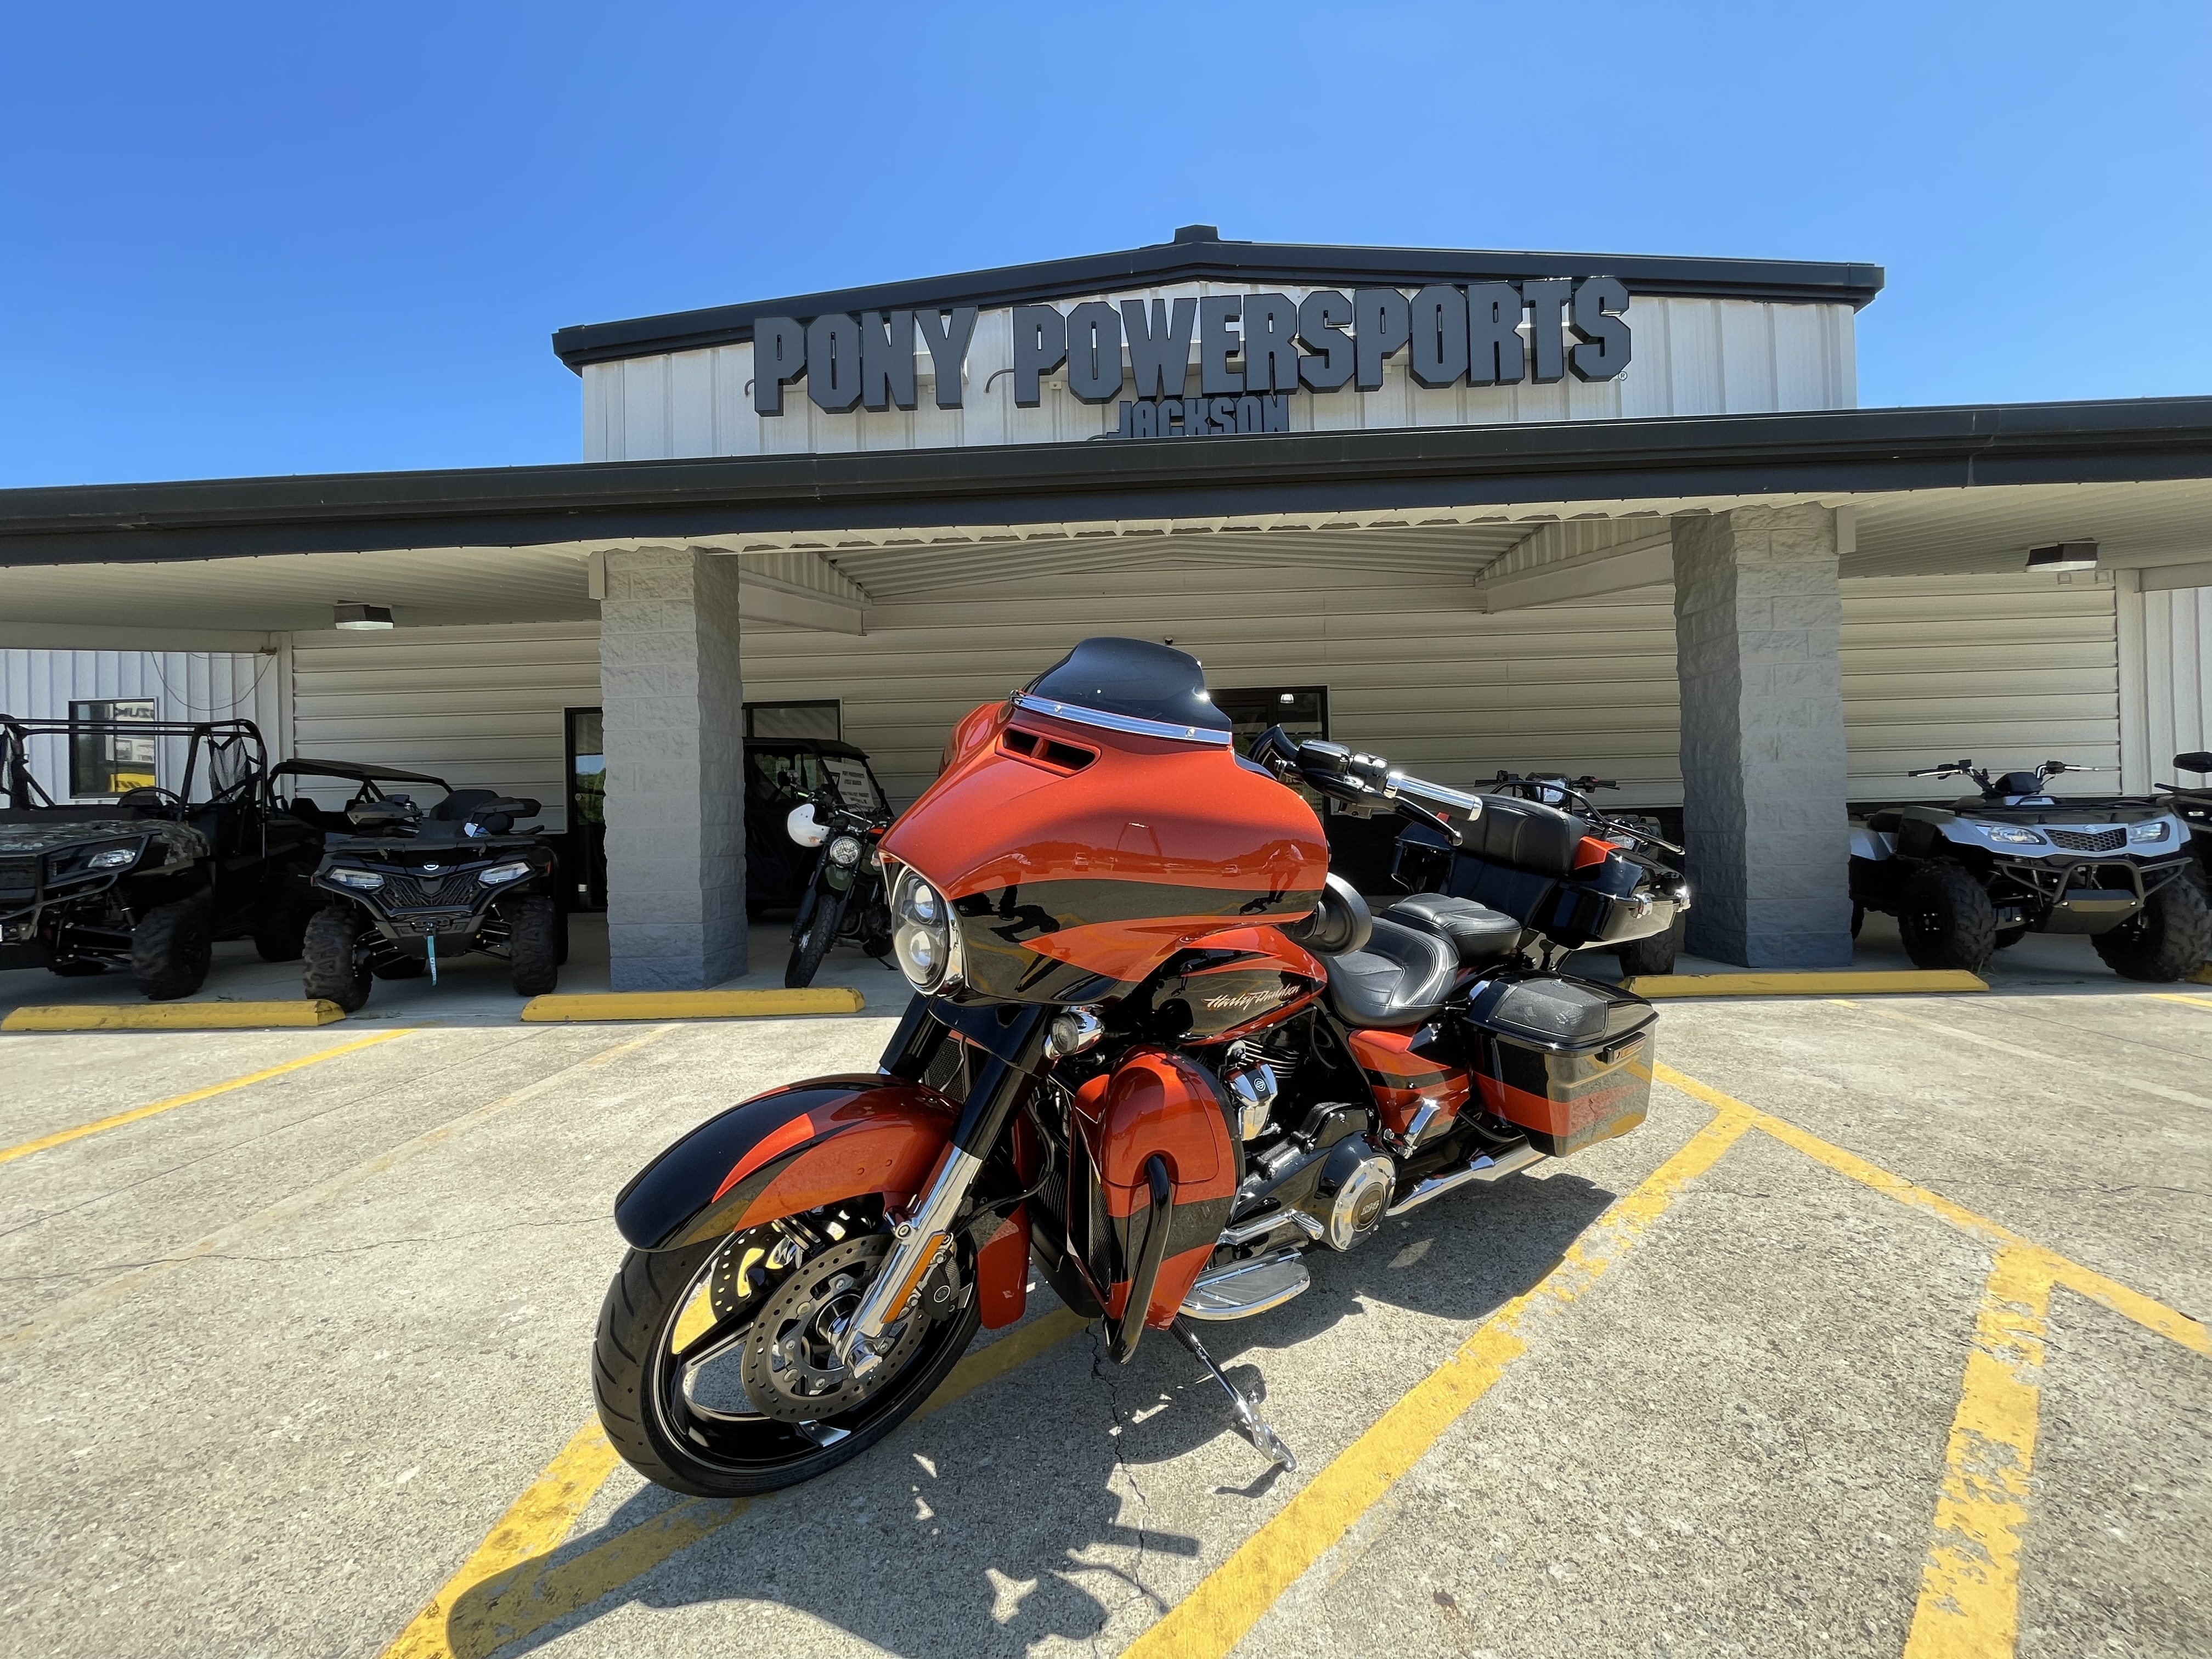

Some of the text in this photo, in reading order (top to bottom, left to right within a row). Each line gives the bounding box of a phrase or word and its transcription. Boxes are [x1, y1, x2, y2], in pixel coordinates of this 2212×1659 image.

[753, 275, 1632, 416] PONY POWERSPORTS
[1107, 394, 1290, 440] JACKSON
[1201, 983, 1301, 1012] Harley-Davidson
